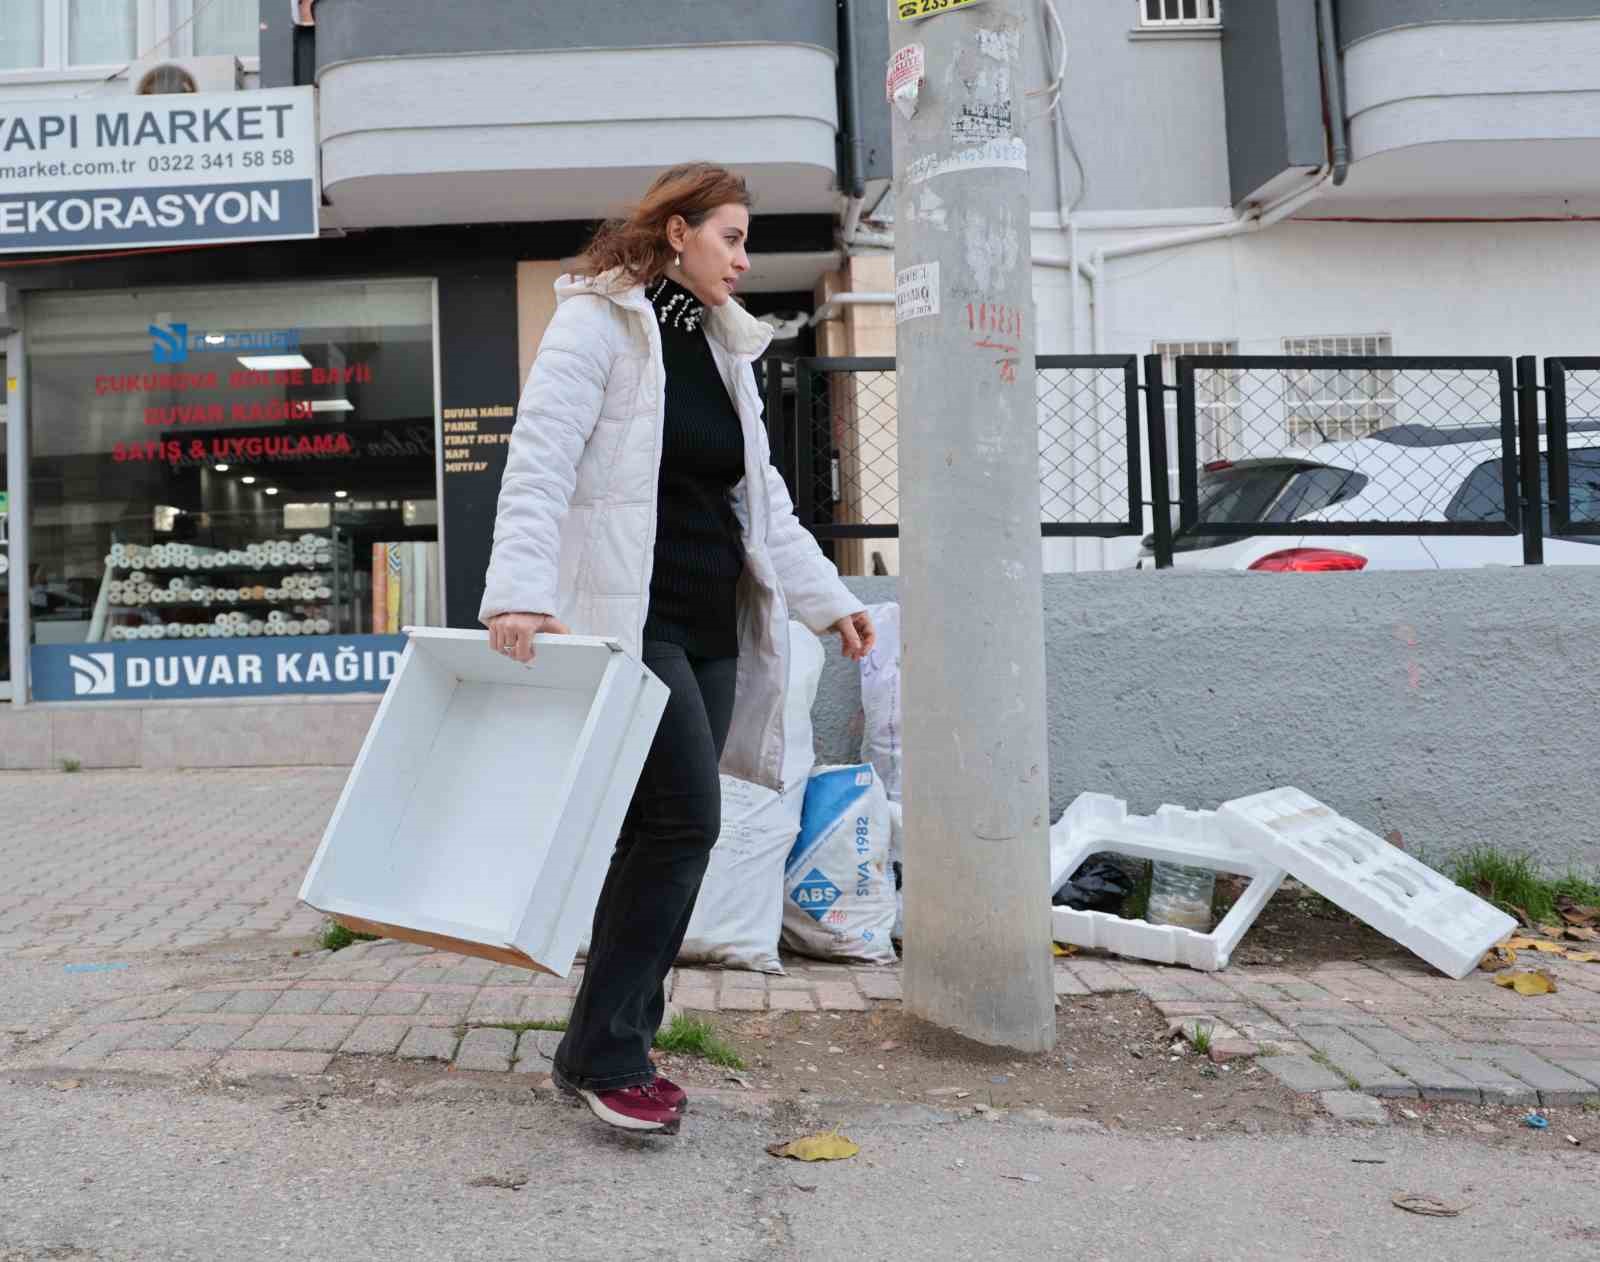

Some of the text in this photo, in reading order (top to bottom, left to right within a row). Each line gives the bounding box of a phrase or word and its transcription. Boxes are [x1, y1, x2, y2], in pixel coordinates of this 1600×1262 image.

[0, 104, 294, 152] API MARKET
[0, 149, 295, 179] market.com.tr 0322 341 58 58
[144, 403, 226, 426] DUVAR
[112, 438, 181, 465] SATIŞ
[189, 440, 208, 458] &
[213, 433, 351, 458] UYGULAMA
[126, 654, 263, 688] DUVAR
[856, 816, 871, 897] SIVA 1982
[797, 887, 837, 903] ABS
